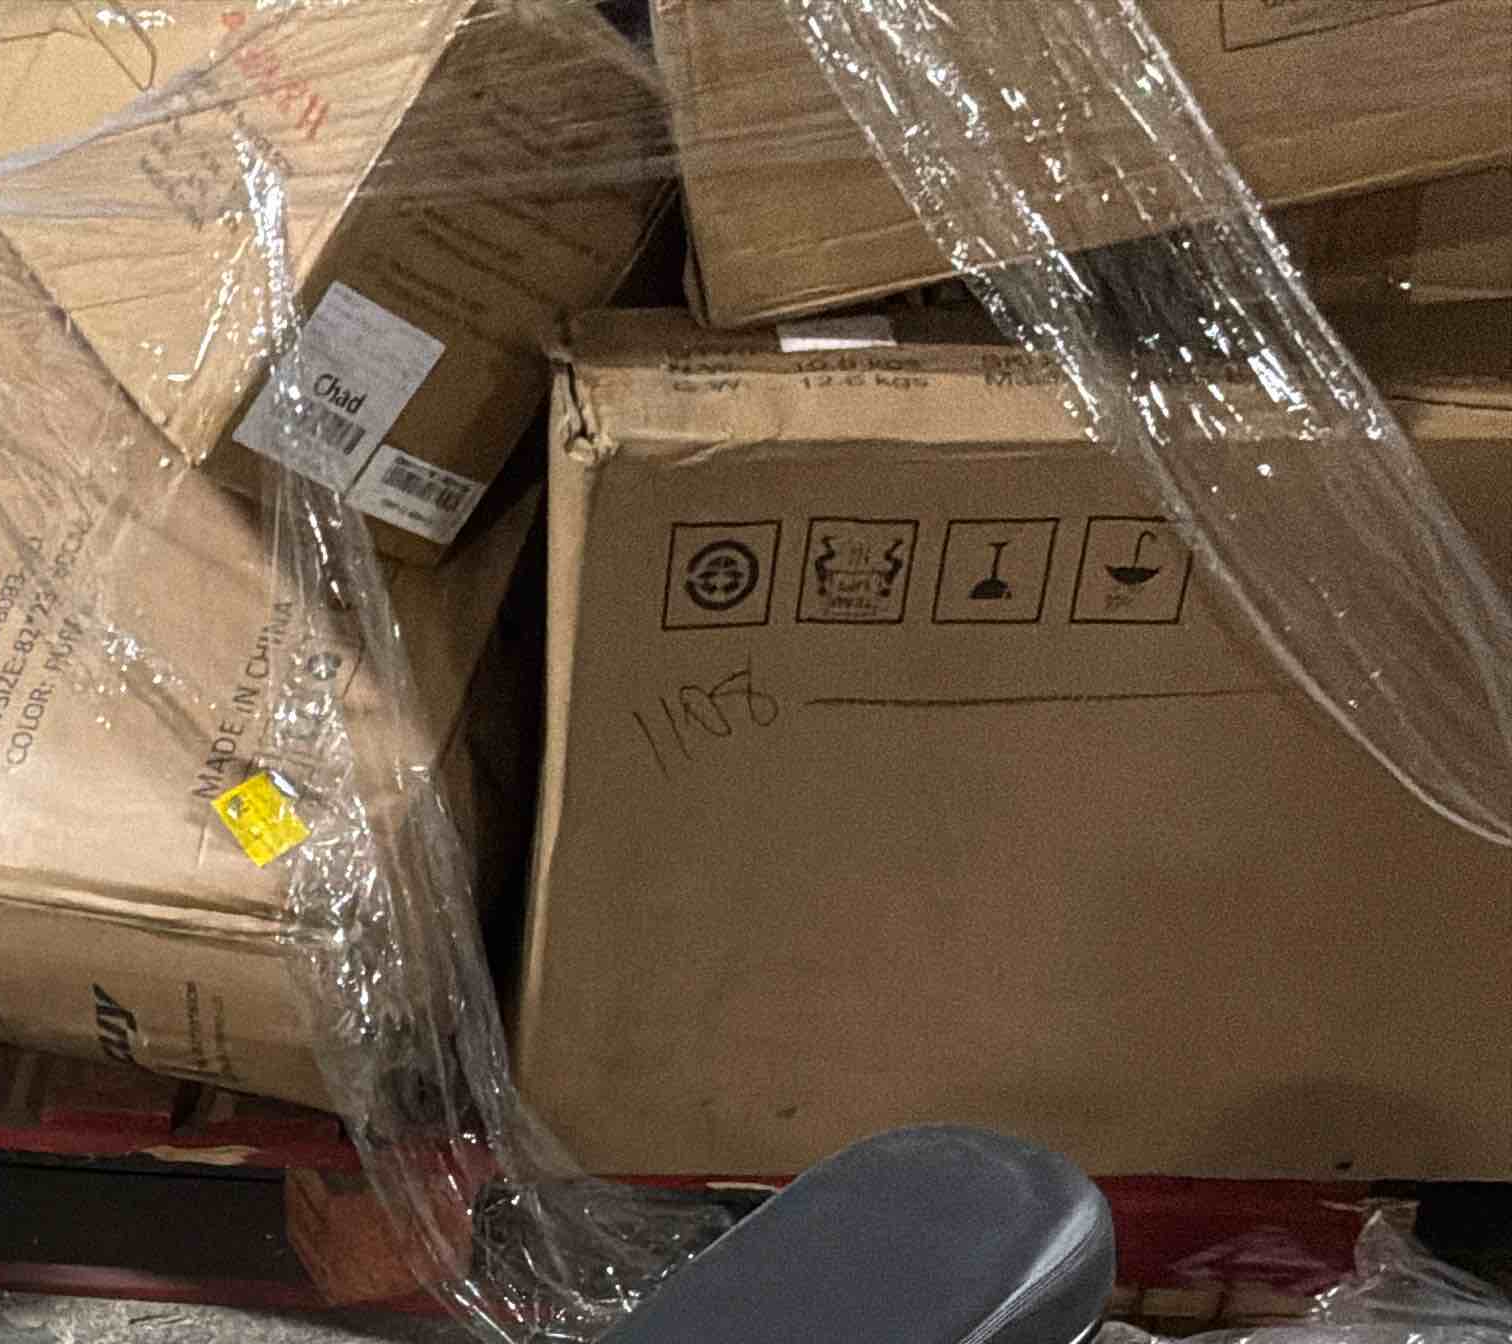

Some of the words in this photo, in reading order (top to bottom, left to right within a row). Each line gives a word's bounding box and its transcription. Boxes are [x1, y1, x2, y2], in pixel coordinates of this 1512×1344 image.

[313, 373, 368, 415] Chad
[245, 600, 294, 680] CHINA
[6, 681, 54, 766] COLOR:
[233, 685, 261, 715] IN
[192, 718, 246, 799] MADE
